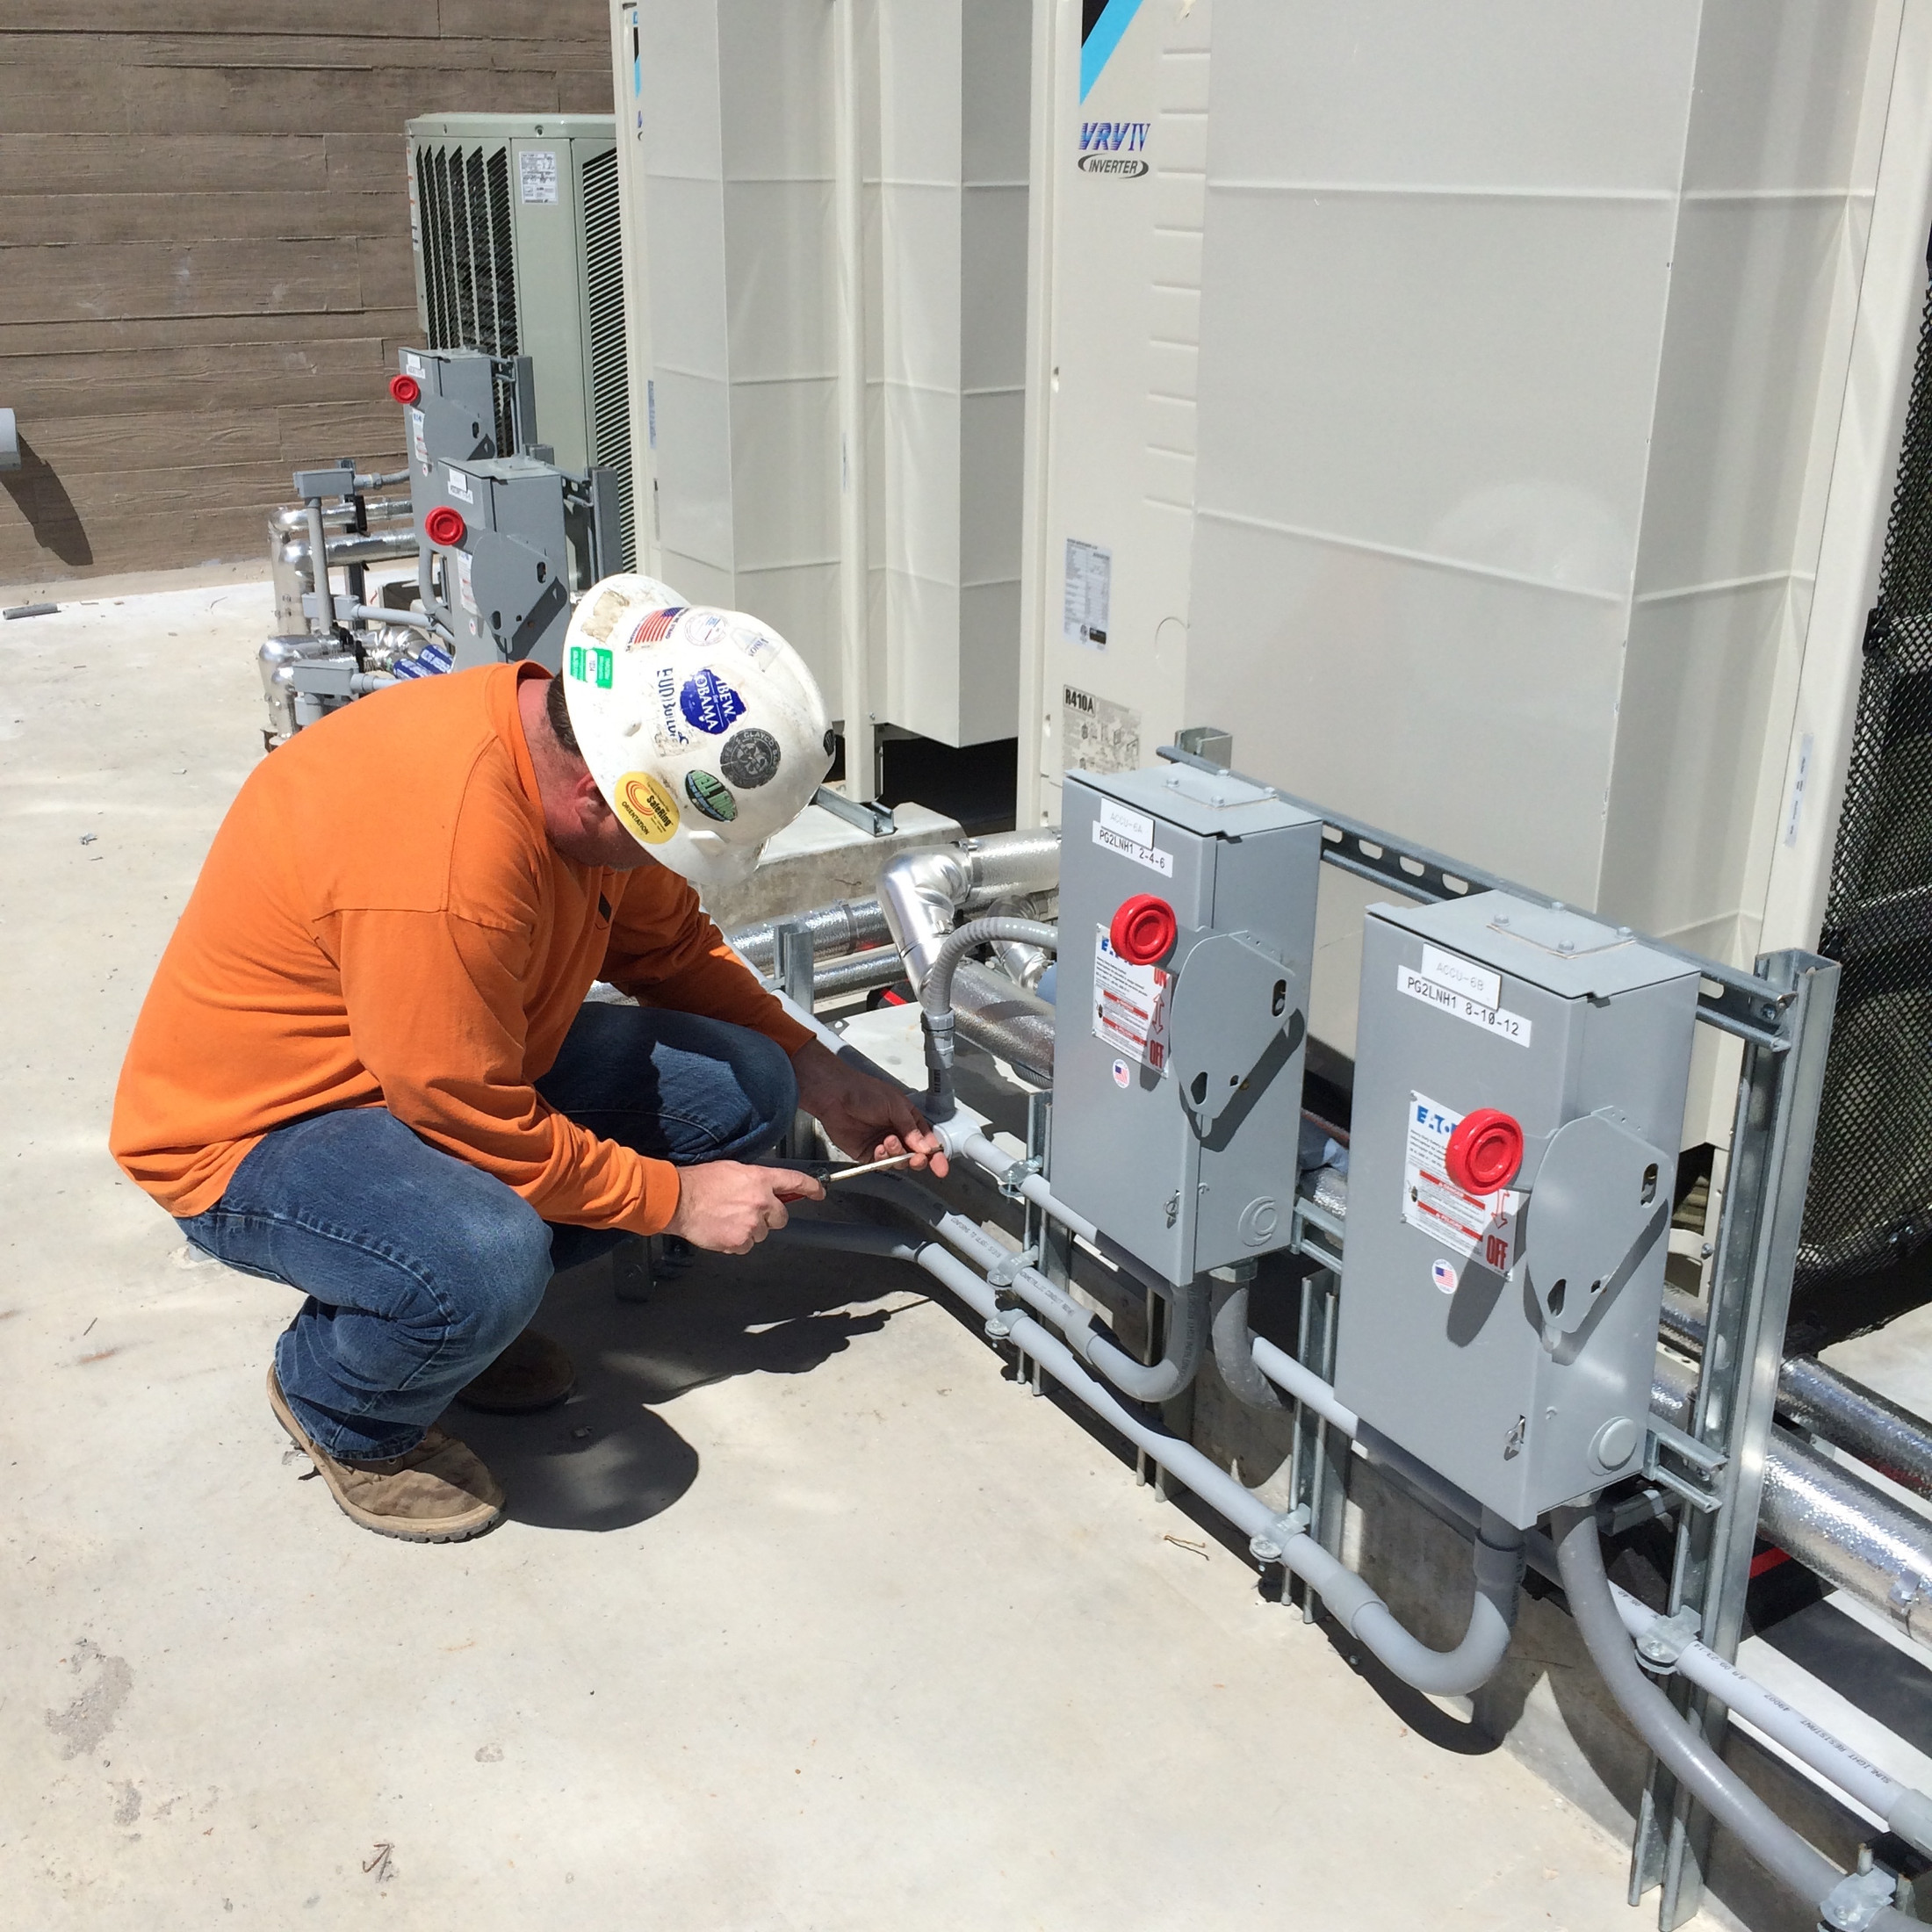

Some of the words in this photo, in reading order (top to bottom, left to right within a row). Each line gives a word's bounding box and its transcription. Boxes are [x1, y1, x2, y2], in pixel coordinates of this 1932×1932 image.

[1089, 159, 1138, 174] INVERTER
[695, 674, 719, 731] OBAMA
[715, 680, 737, 717] IBEW
[1065, 688, 1094, 715] R410A
[621, 801, 650, 836] ORIENTATION
[646, 795, 673, 827] SafeRing
[1099, 830, 1133, 854] PG2LNH1
[1139, 847, 1165, 869] 2-4-6
[1407, 977, 1457, 1009] PG2LNH1
[1150, 1039, 1164, 1070] OFF
[1486, 1234, 1509, 1270] OFF
[1800, 1719, 1847, 1753] RESISTANT
[1847, 1752, 1892, 1784] SUNLIGHT
